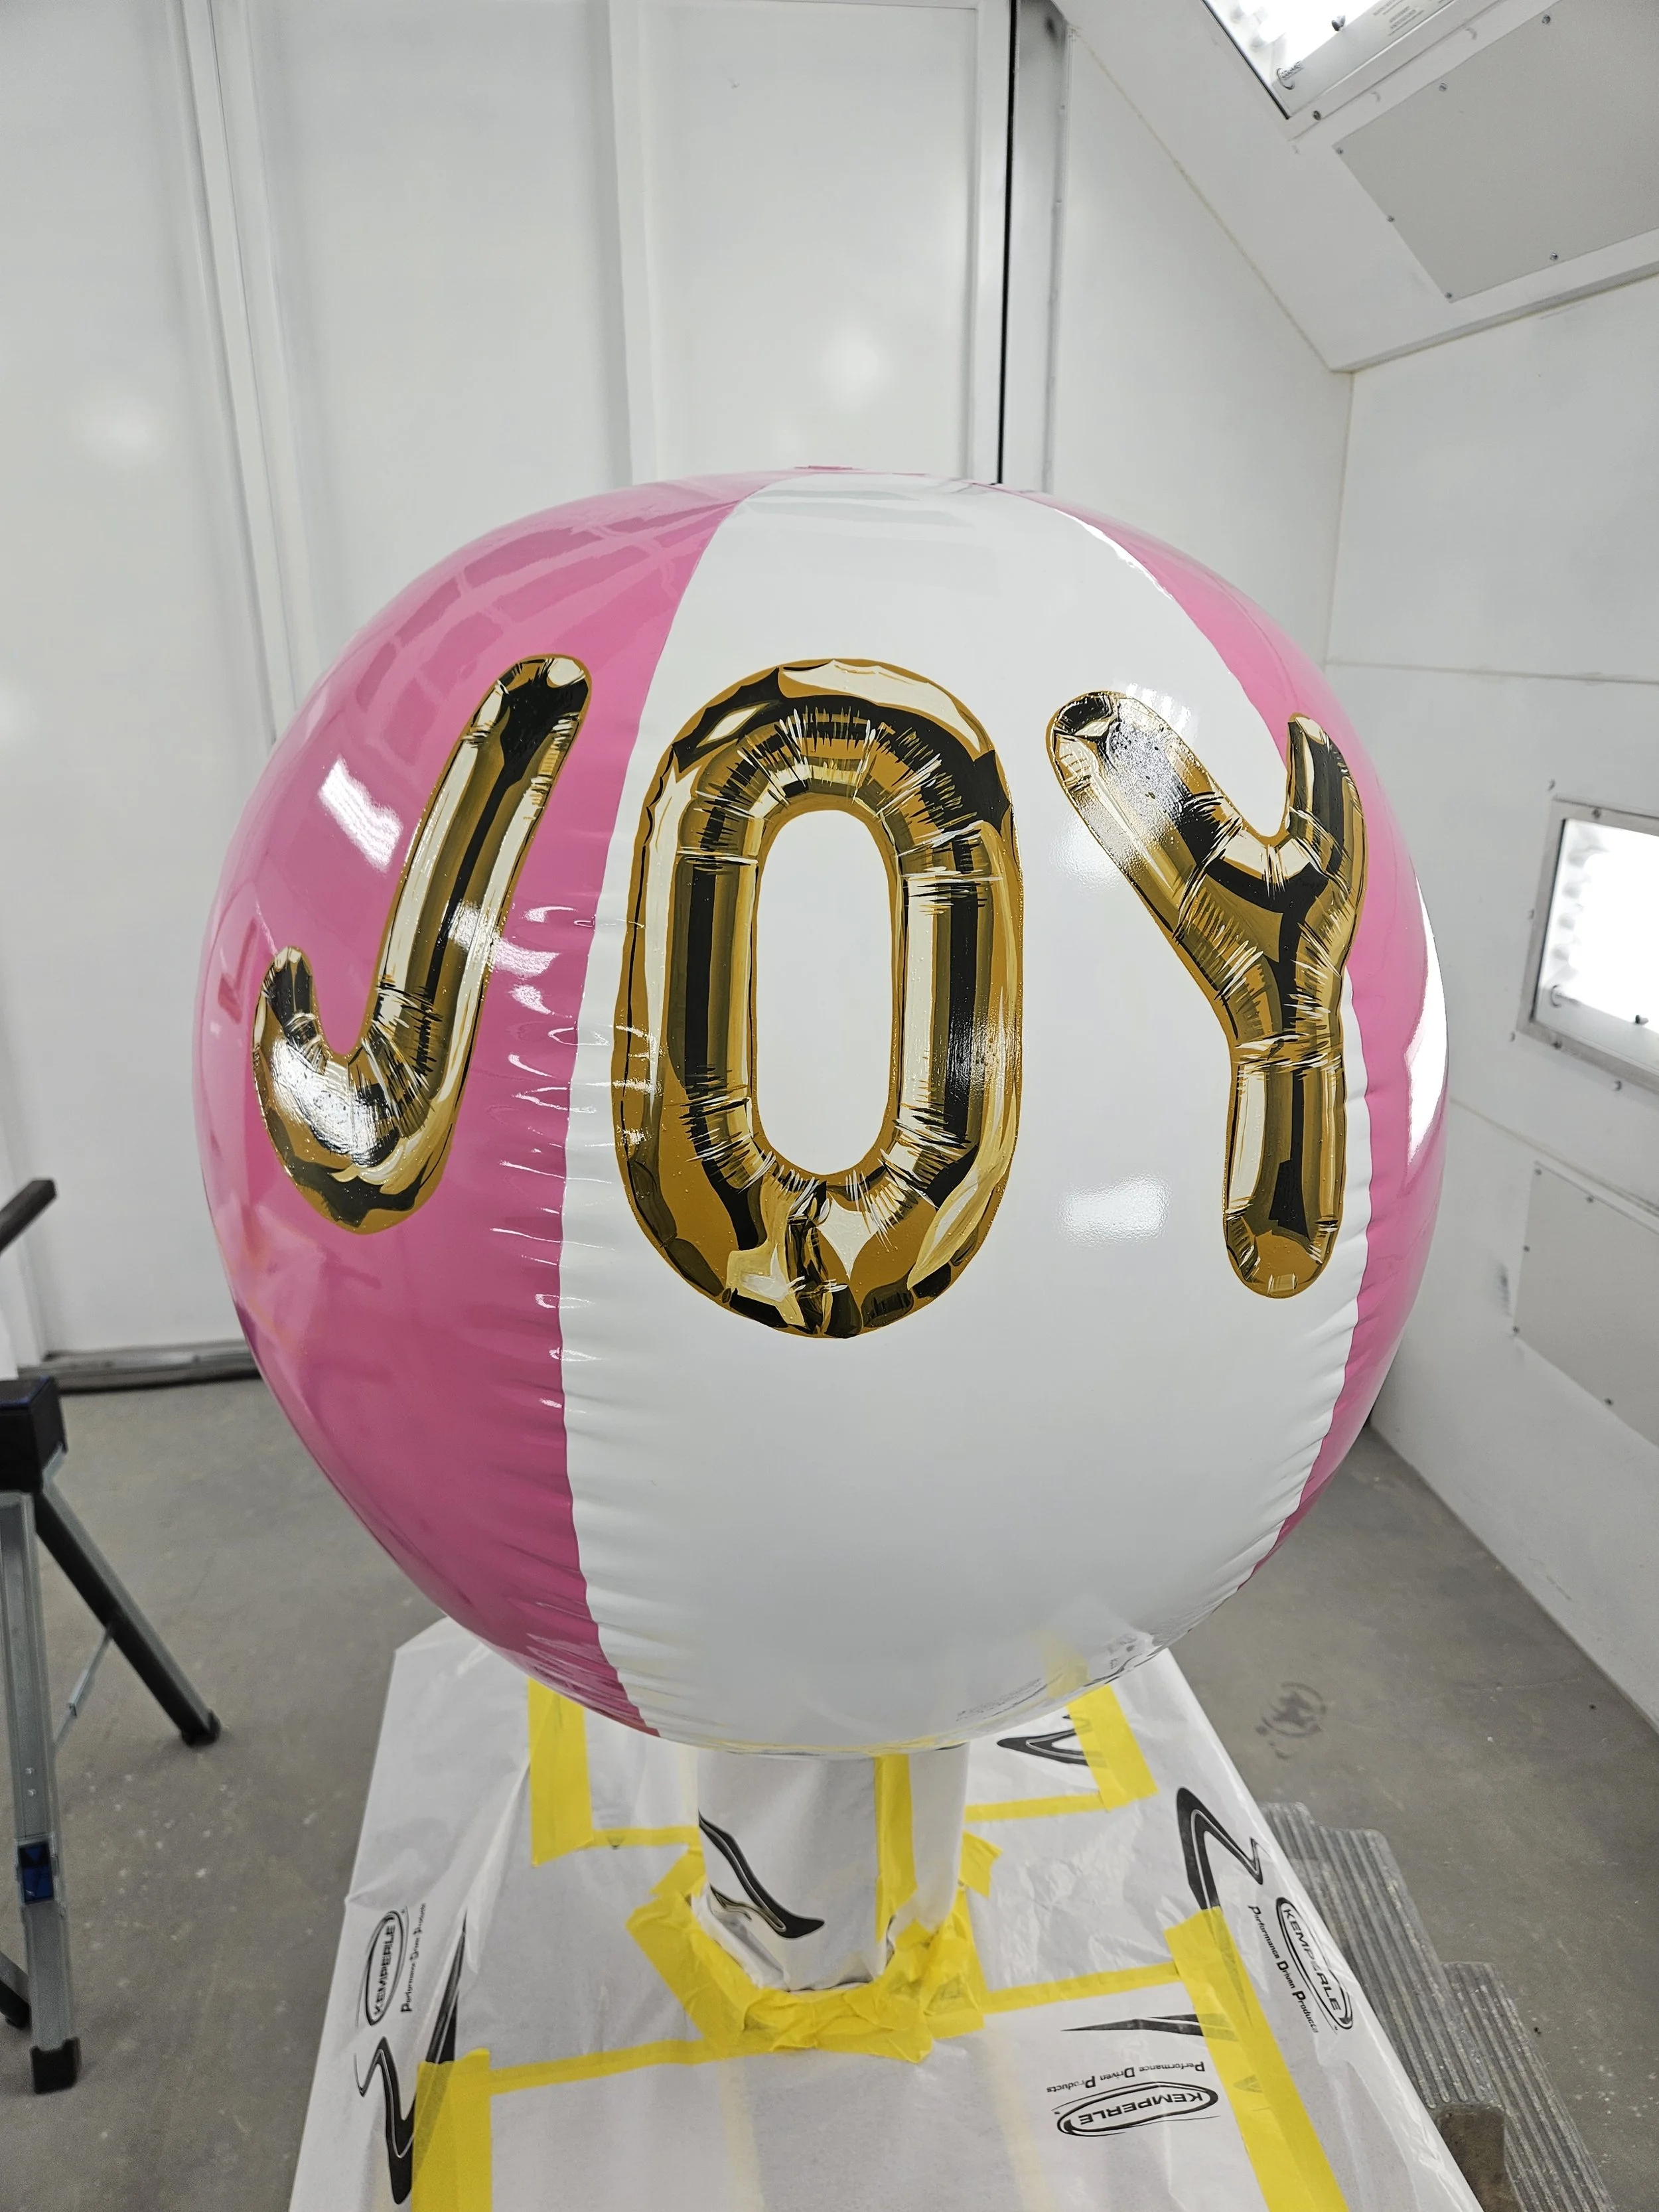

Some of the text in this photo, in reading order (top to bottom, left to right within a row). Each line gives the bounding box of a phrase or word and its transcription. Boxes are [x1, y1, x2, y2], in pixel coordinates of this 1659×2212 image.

[253, 654, 1366, 1339] JOY
[374, 1925, 396, 2015] KEMPERLE
[1248, 1905, 1280, 1960] Performance
[1276, 1960, 1296, 1989] Driven
[1046, 2061, 1205, 2093] Performance Driven Products
[1078, 2092, 1204, 2125] KEMPERLE
